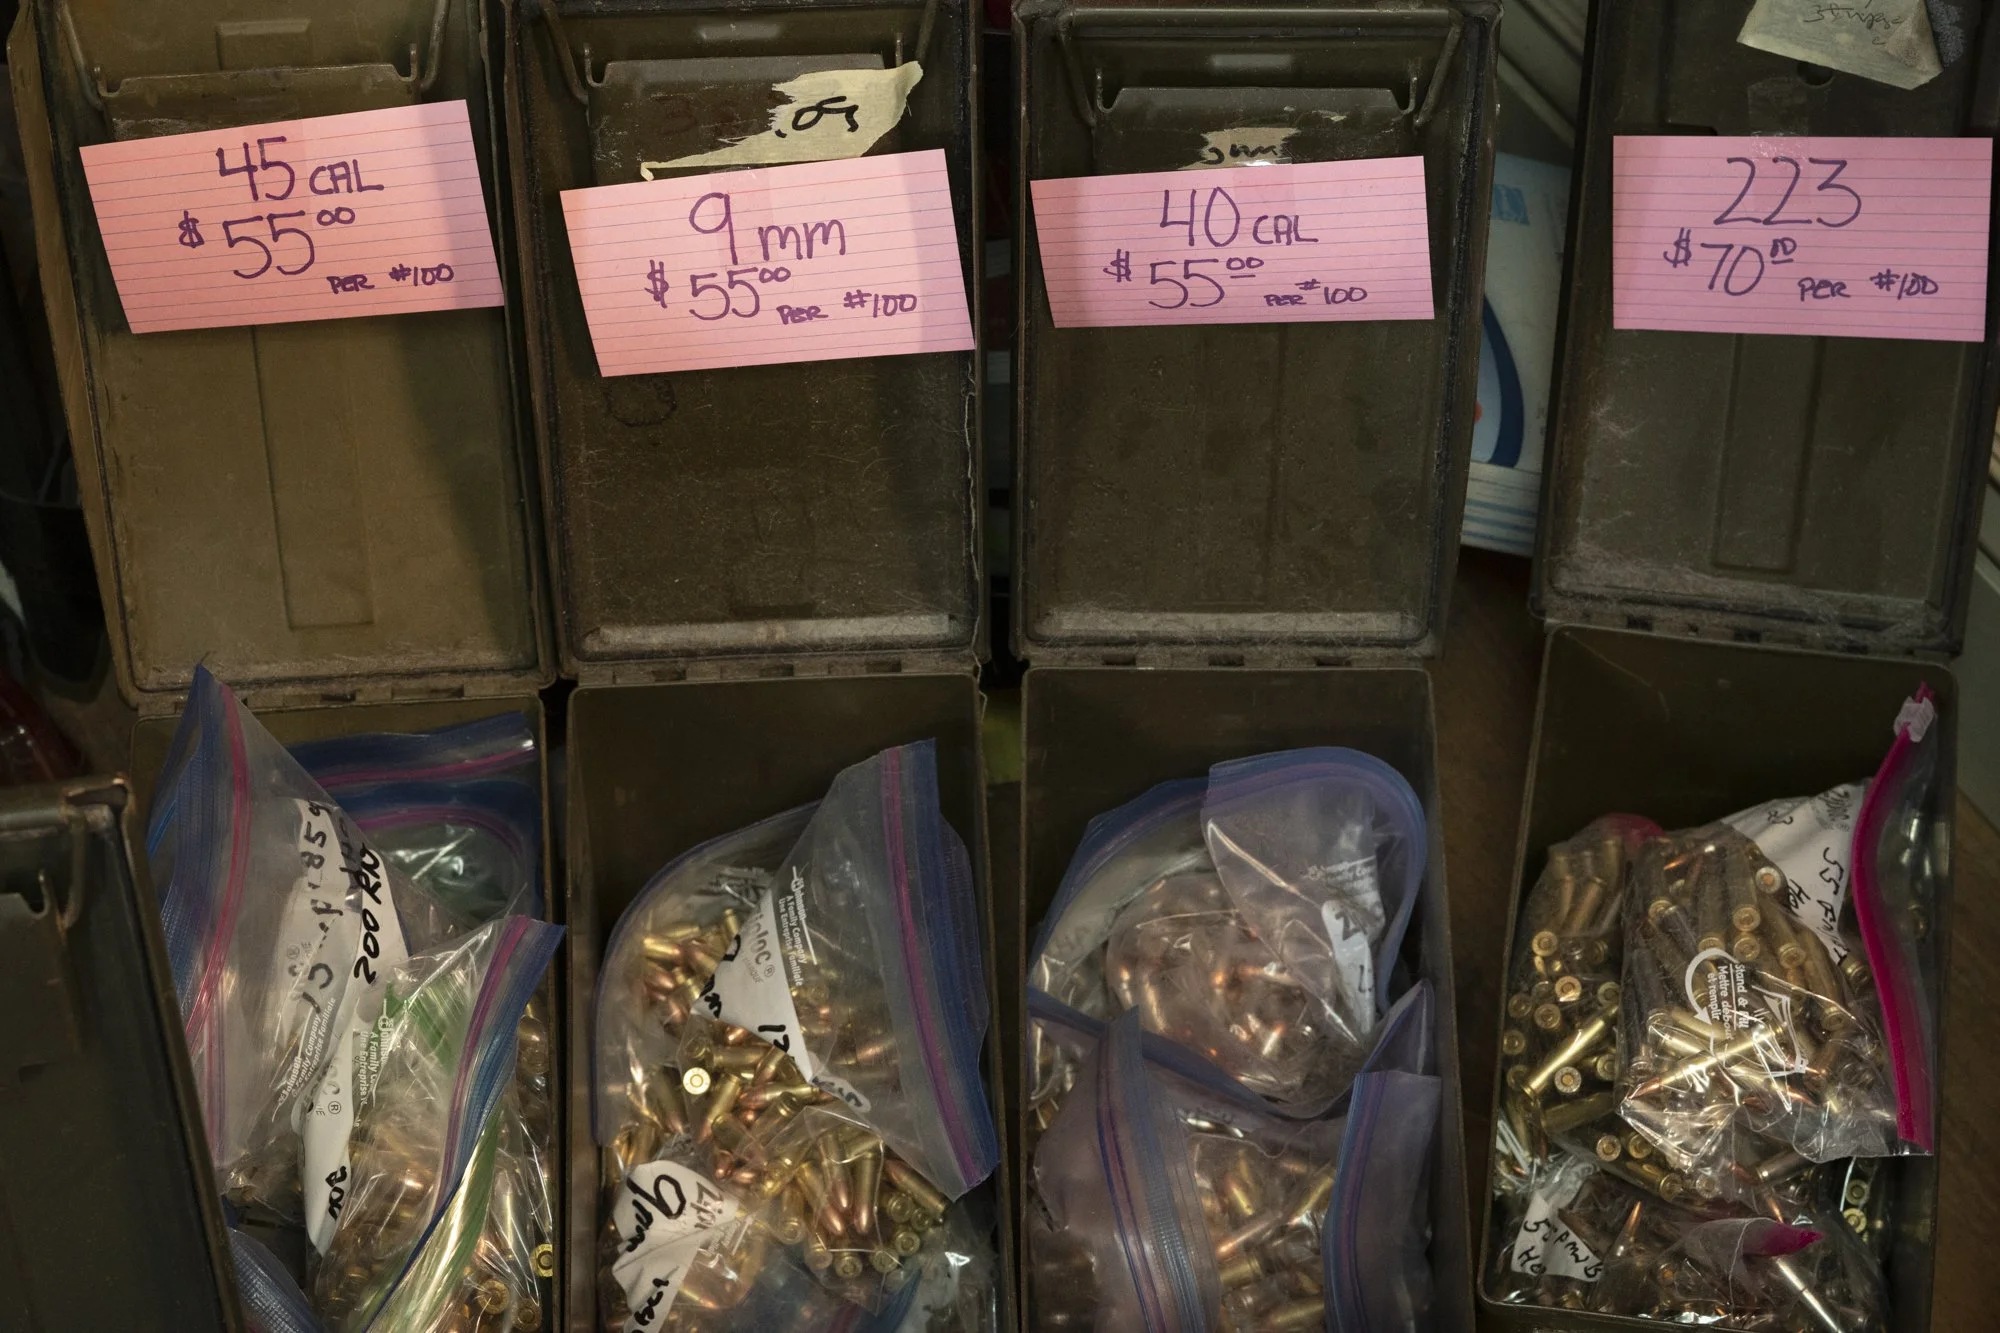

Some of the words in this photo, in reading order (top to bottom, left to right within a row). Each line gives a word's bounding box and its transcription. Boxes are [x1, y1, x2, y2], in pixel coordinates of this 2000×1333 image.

[216, 136, 295, 200] 45
[309, 159, 384, 195] CAL
[1713, 156, 1862, 228] 223
[689, 192, 738, 266] 9
[758, 218, 846, 262] mm
[1160, 186, 1240, 247] 40
[1252, 215, 1319, 246] CAL
[327, 273, 375, 294] PER
[1264, 294, 1307, 307] PER
[1798, 277, 1852, 301] PER
[776, 305, 829, 325] PER
[354, 909, 379, 985] 200
[794, 929, 807, 964] Company
[1717, 965, 1730, 997] Mettre
[1735, 964, 1748, 993] Stand
[319, 997, 337, 1040] Familiale
[1708, 983, 1721, 1021] remplir
[307, 1014, 322, 1057] Company
[359, 1051, 369, 1096] Entreprise
[369, 1041, 379, 1072] Family
